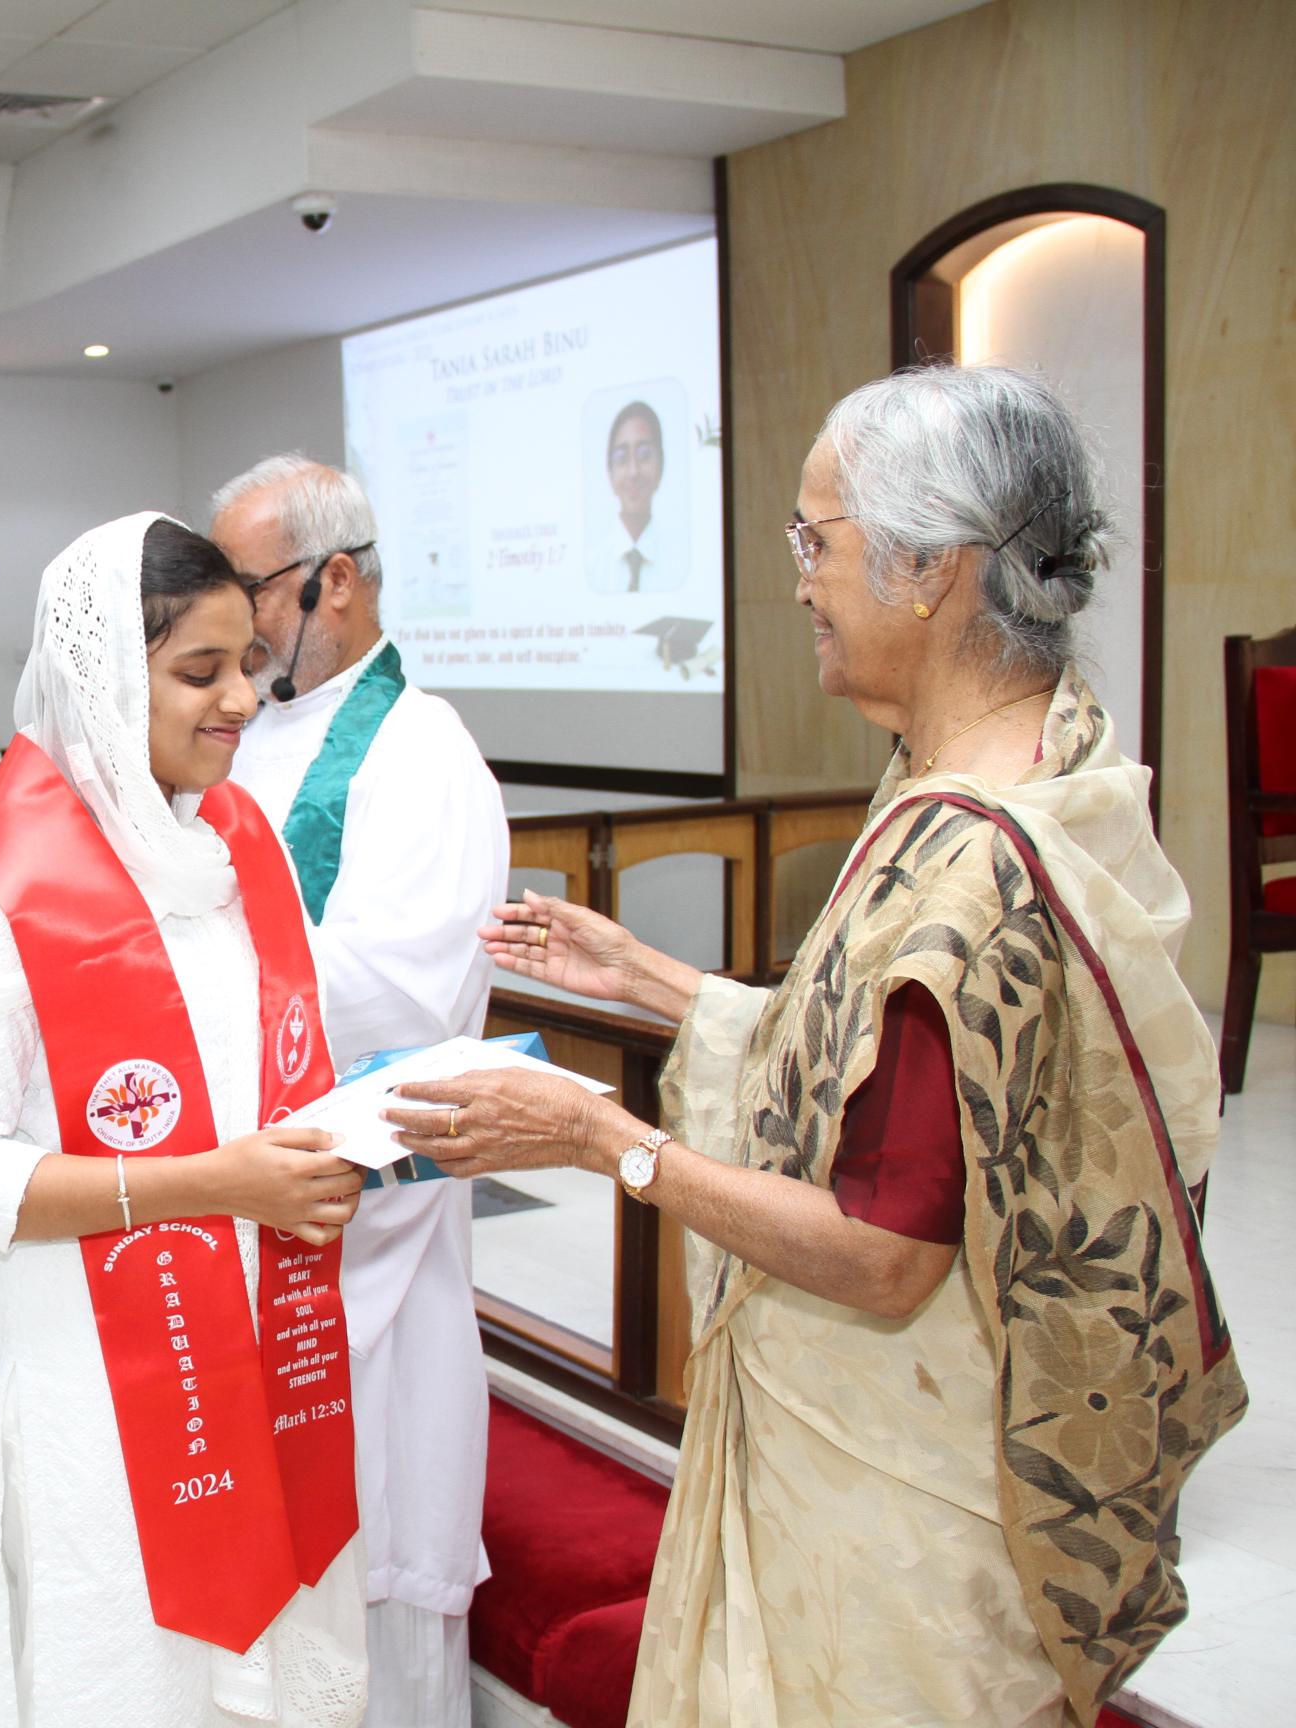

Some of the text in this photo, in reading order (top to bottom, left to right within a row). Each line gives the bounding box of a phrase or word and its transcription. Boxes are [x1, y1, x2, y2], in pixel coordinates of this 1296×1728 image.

[429, 354, 478, 384] TANIA
[481, 337, 536, 371] SARAH
[542, 324, 589, 357] BINU
[90, 1089, 102, 1107] THAT
[100, 1071, 116, 1090] THEY
[118, 1065, 132, 1075] ALL
[151, 1066, 161, 1076] BE
[161, 1073, 174, 1088] ONE
[96, 1127, 123, 1146] CHURCH
[138, 1130, 164, 1146] SOUTH
[162, 1109, 176, 1130] INDIA
[103, 1222, 219, 1273] SUNDAY SCHOOL
[277, 1253, 324, 1269] with all your
[288, 1269, 311, 1284] HEART
[273, 1284, 329, 1306] and with all your
[295, 1303, 314, 1318] SOUL
[276, 1317, 337, 1342] and with all your
[156, 1250, 207, 1457] GRADUATION
[296, 1337, 318, 1353] MIND
[277, 1350, 338, 1376] and with all your
[289, 1368, 327, 1389] STRENGTH
[273, 1398, 346, 1435] Mark 12:30
[171, 1468, 235, 1506] 2024
